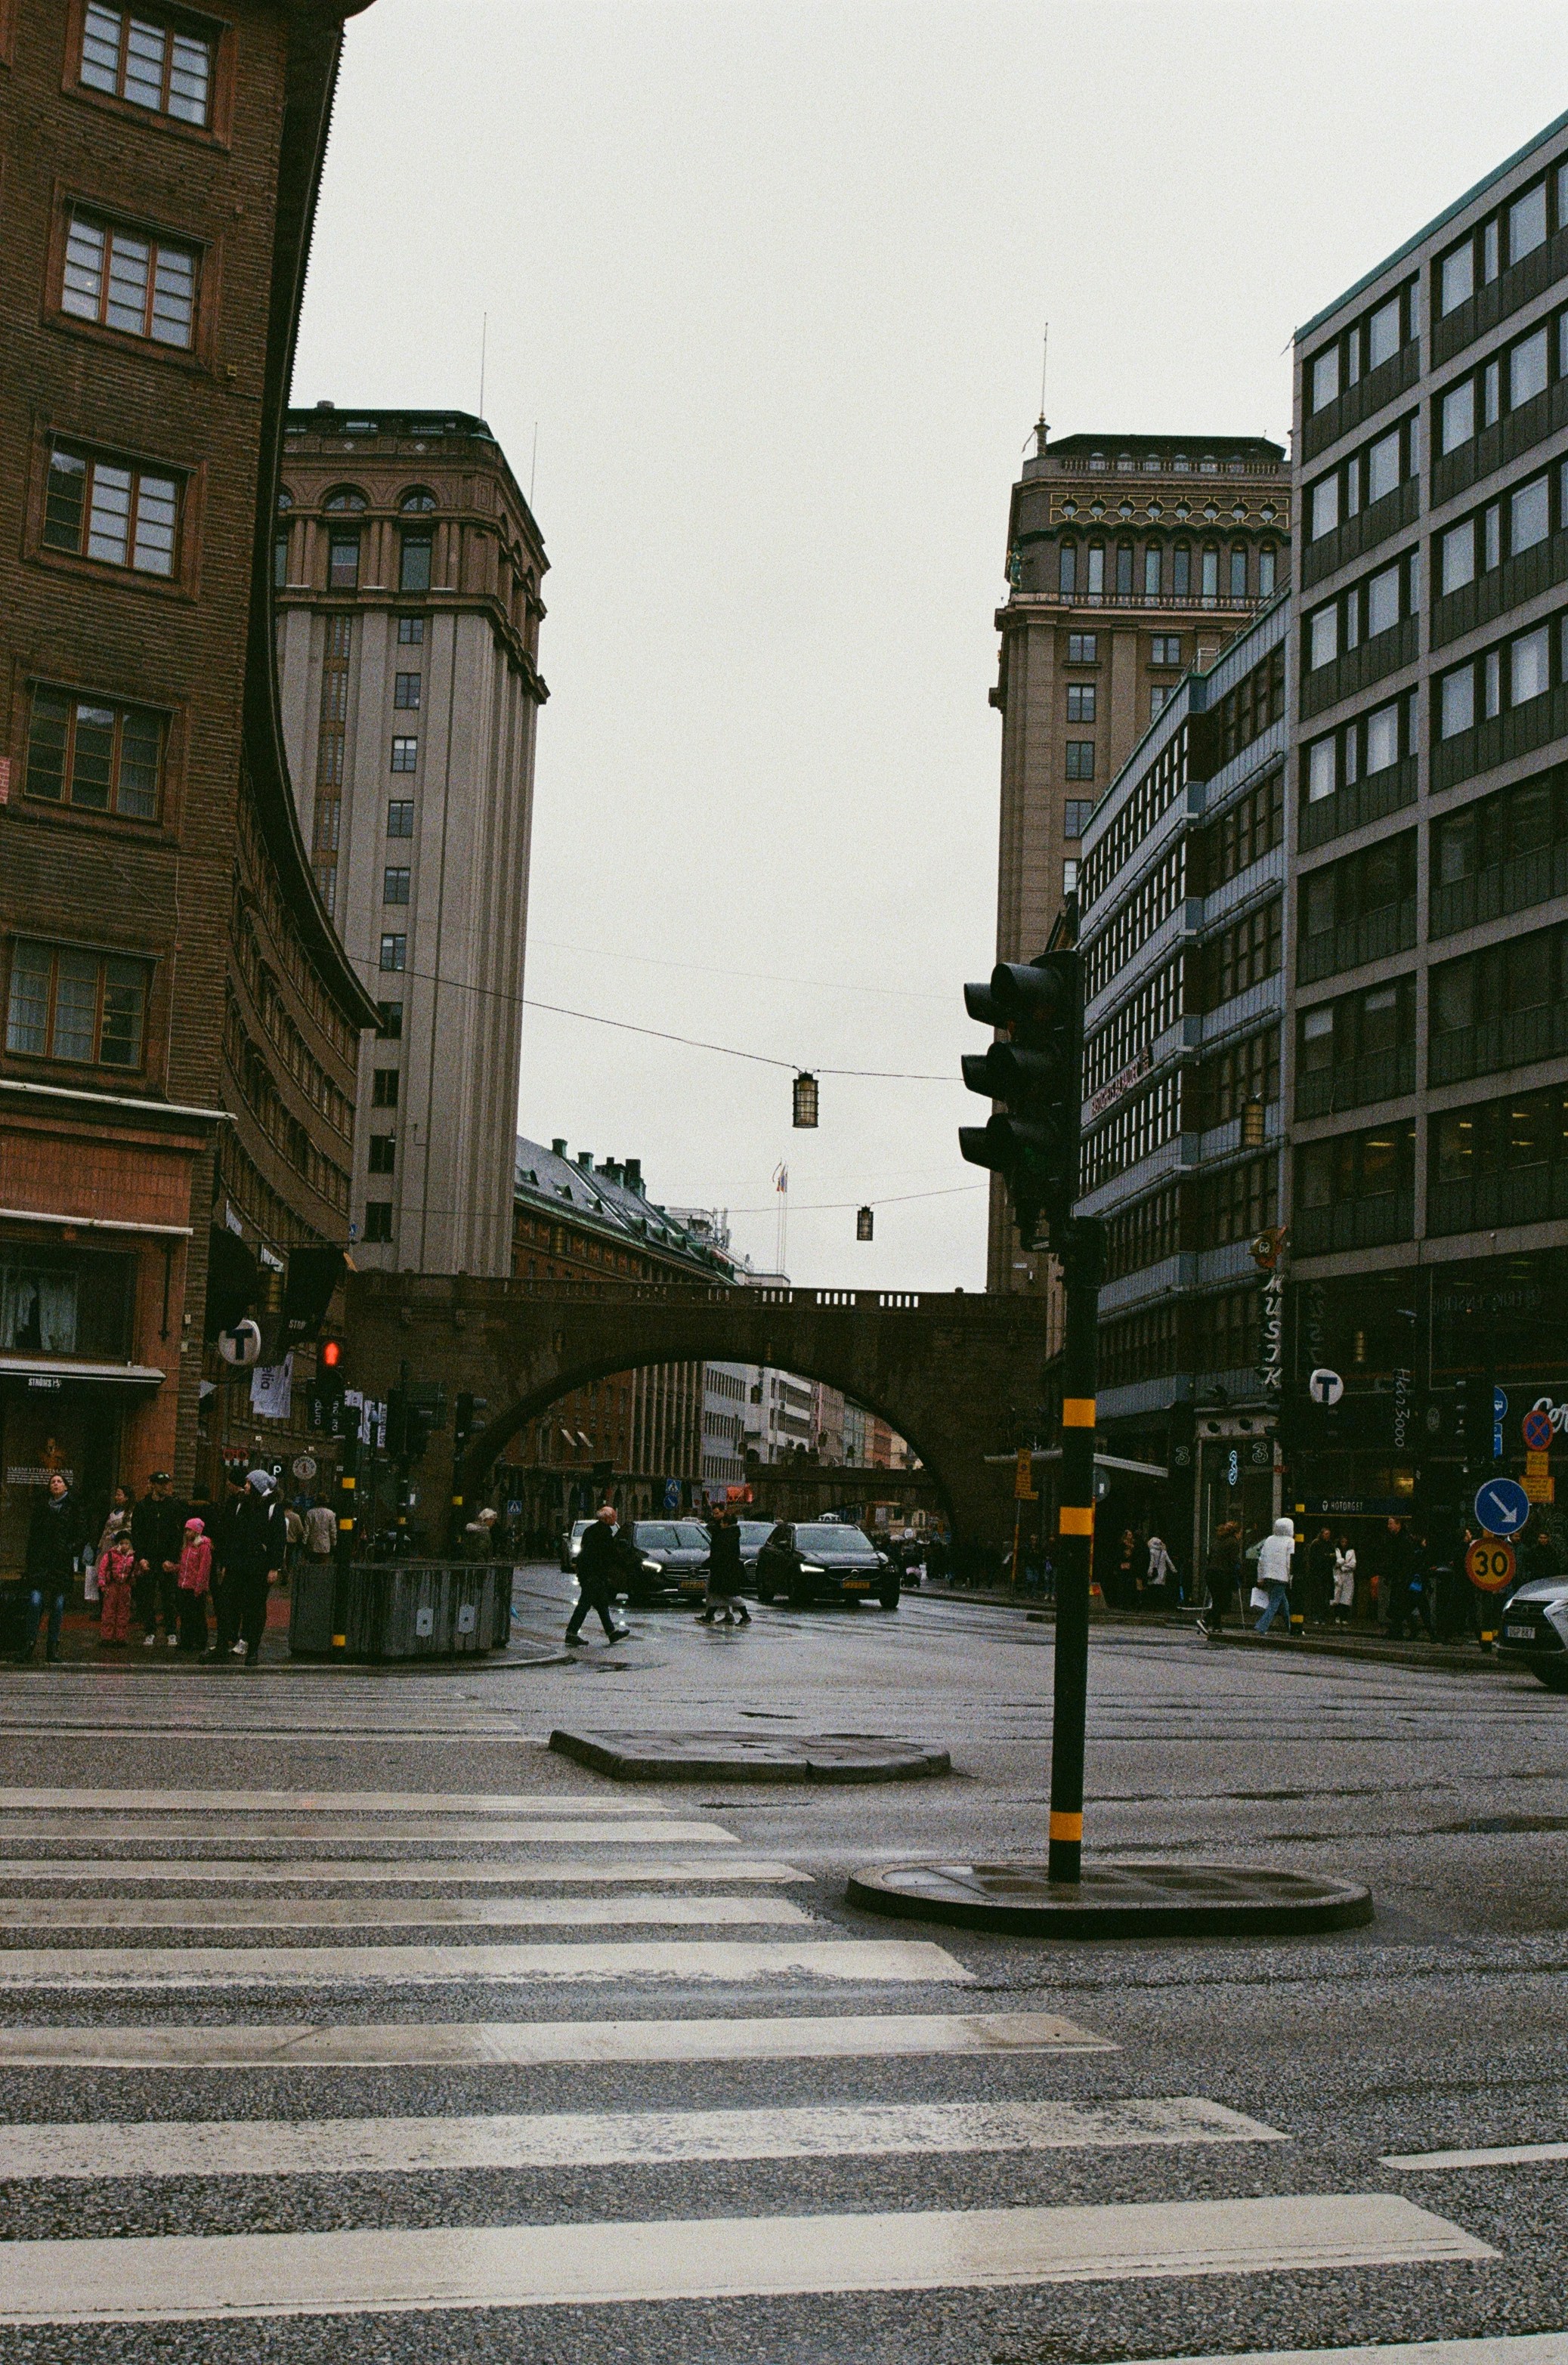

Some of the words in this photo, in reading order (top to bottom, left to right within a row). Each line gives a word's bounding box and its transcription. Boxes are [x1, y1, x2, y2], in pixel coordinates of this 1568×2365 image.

[227, 1328, 253, 1360] T
[1261, 1275, 1285, 1388] MUSIK
[261, 1366, 275, 1390] elia
[1316, 1376, 1338, 1402] T
[1474, 1551, 1508, 1577] 30
